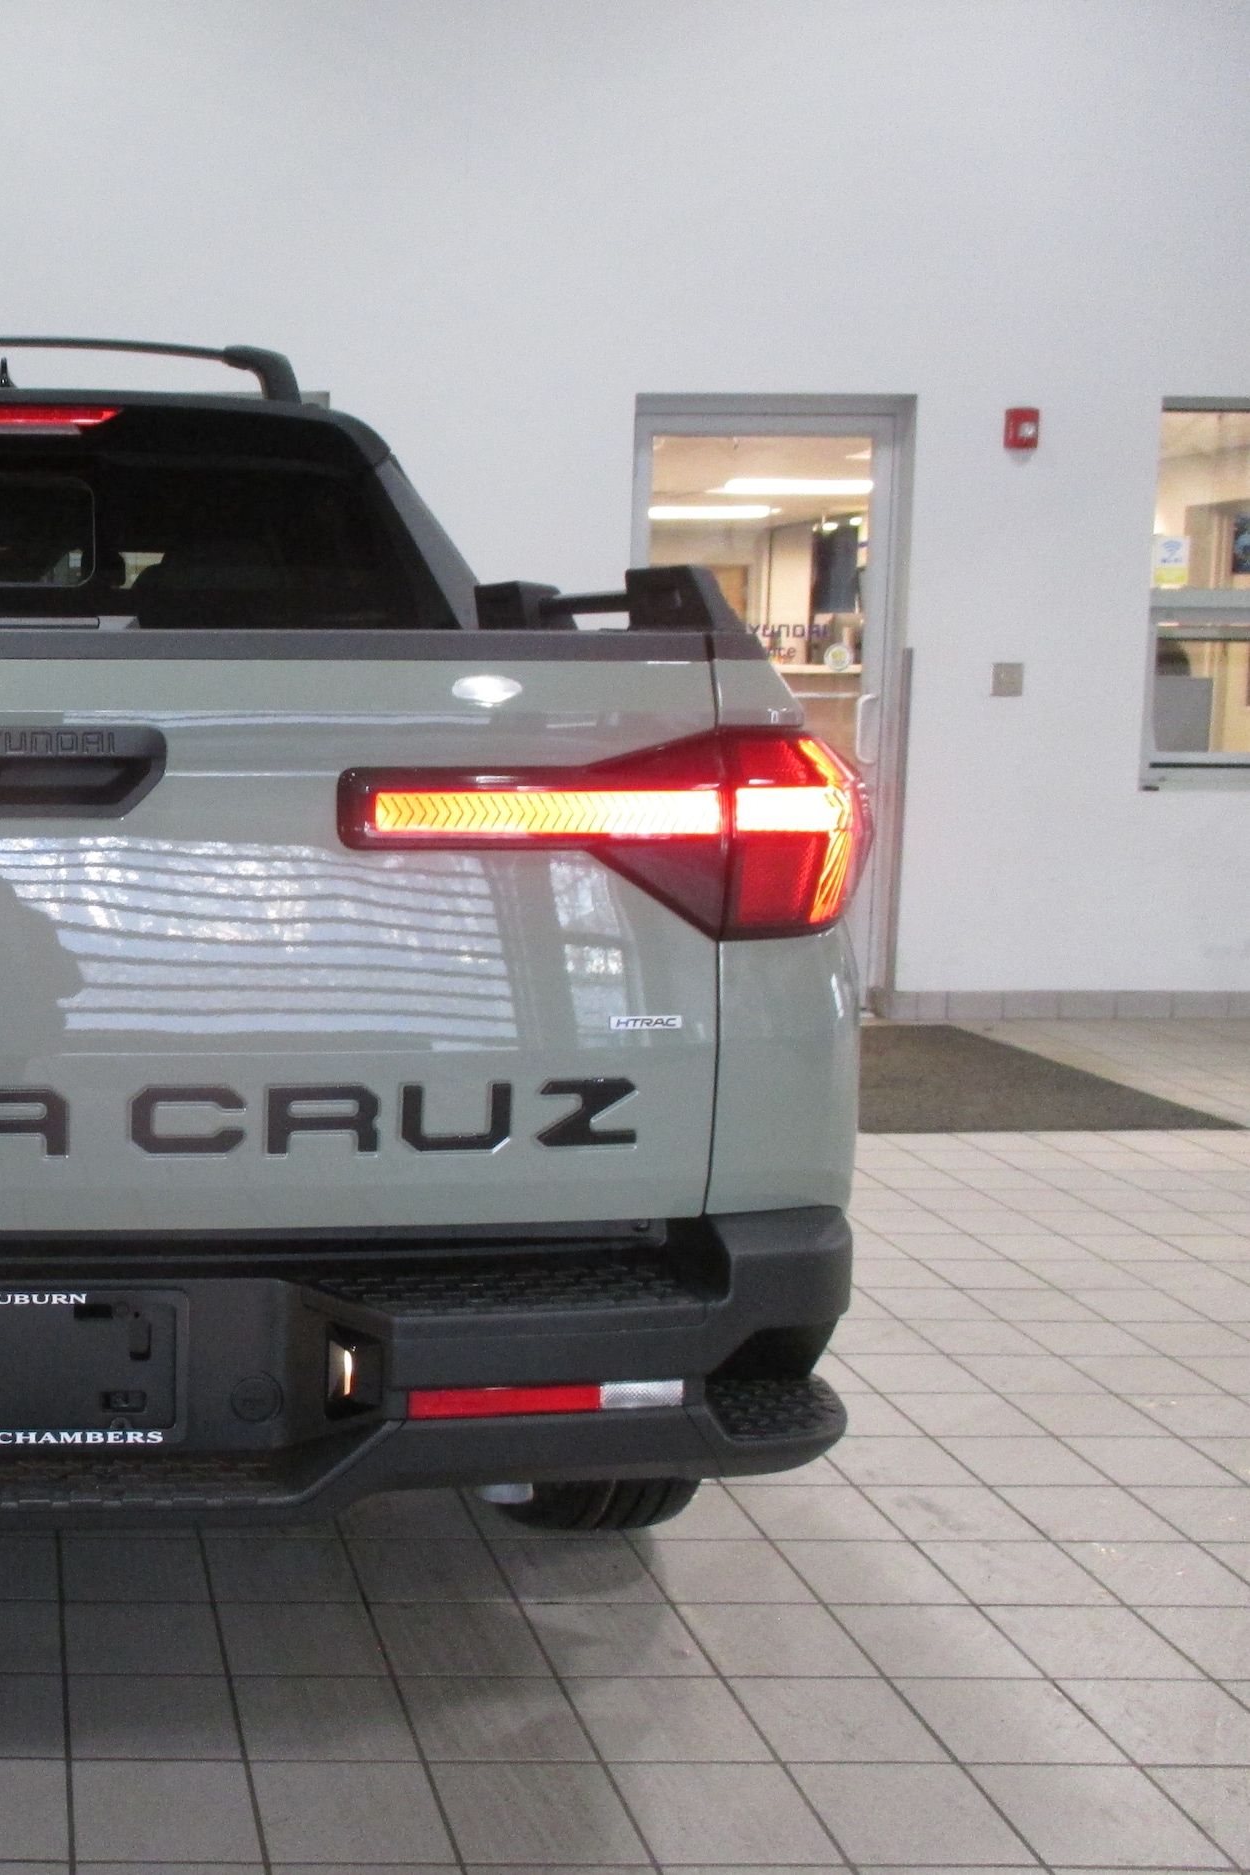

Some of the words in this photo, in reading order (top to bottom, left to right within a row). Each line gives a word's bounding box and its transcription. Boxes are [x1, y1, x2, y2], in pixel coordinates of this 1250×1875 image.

[747, 623, 829, 637] YUNDAI
[615, 1017, 677, 1028] HTRAC
[128, 1077, 640, 1158] CRUZ
